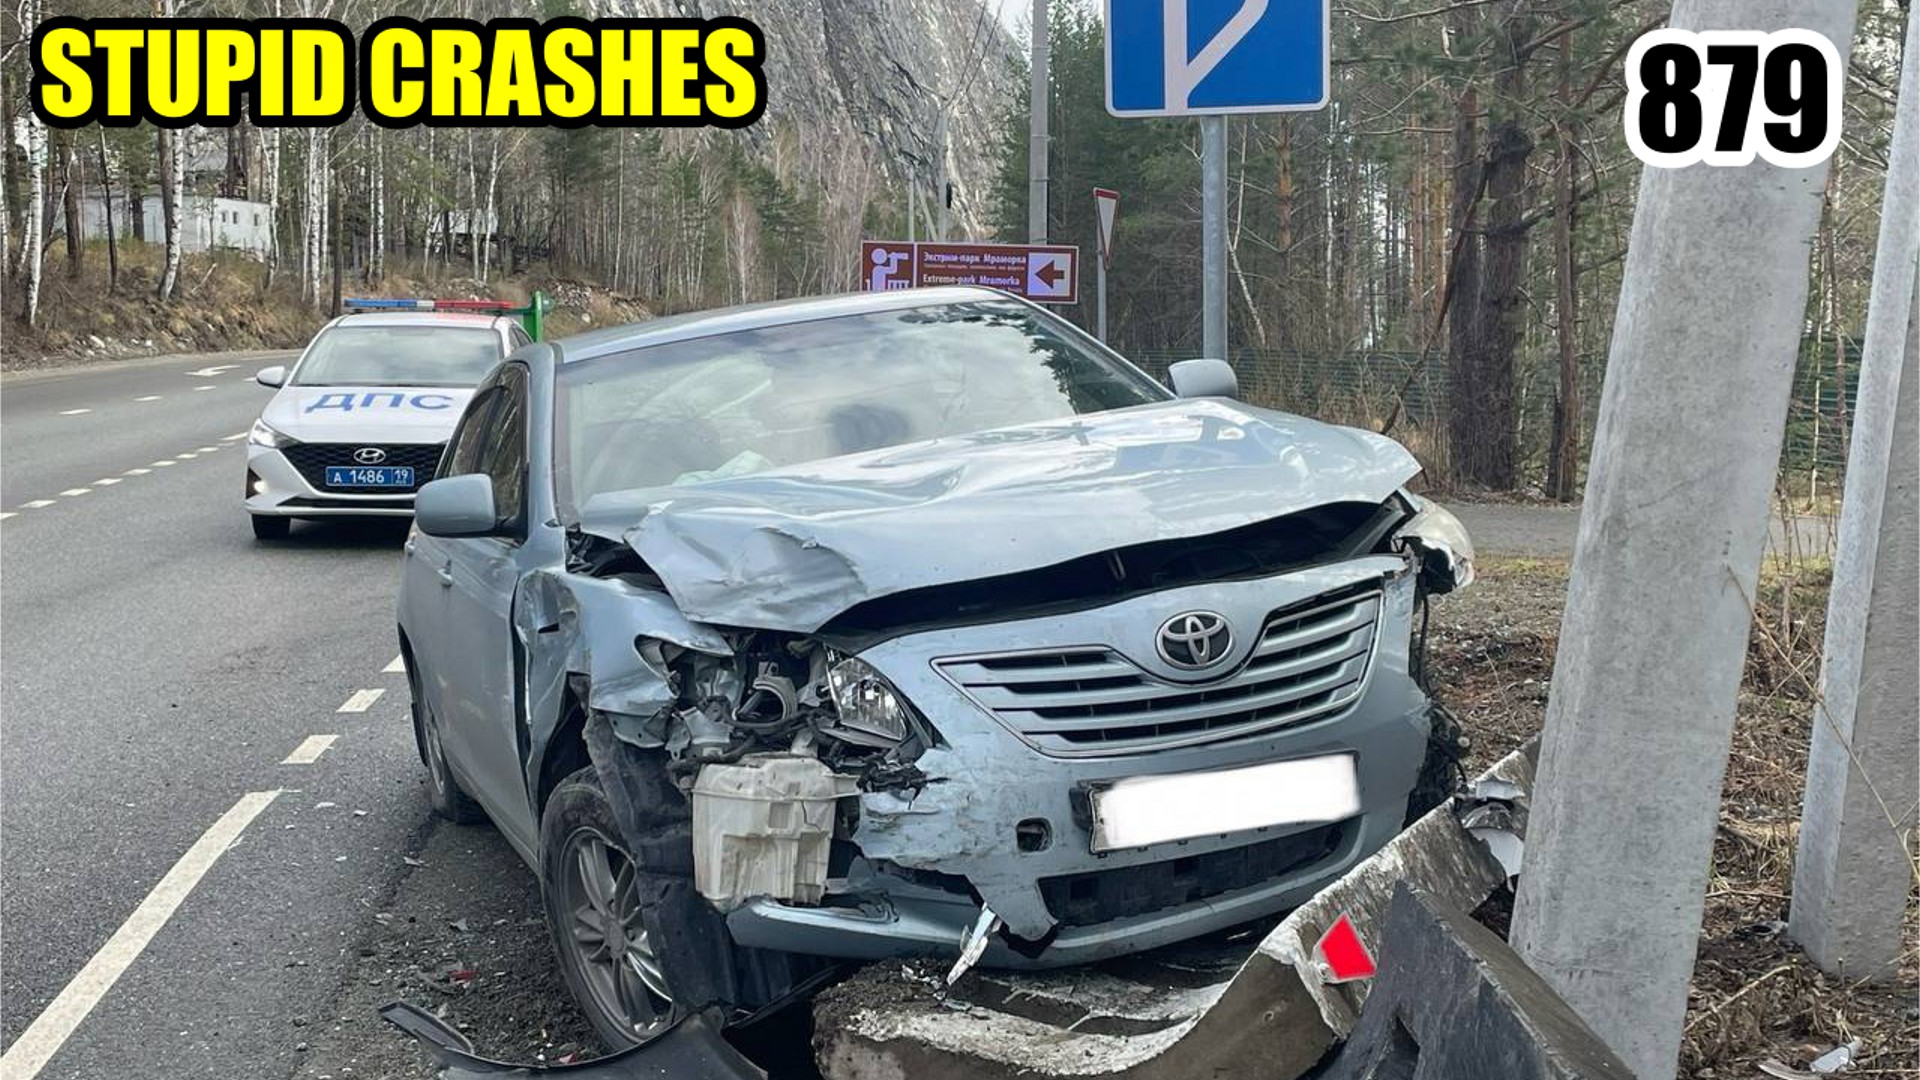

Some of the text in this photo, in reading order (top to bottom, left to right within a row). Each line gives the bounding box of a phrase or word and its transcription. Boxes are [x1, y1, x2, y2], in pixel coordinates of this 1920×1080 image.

[983, 253, 1026, 264] Мраморка
[923, 274, 1019, 285] Extreme-park Mramorka
[304, 392, 455, 414] ДПС
[349, 469, 385, 484] 1486
[394, 469, 409, 481] 19
